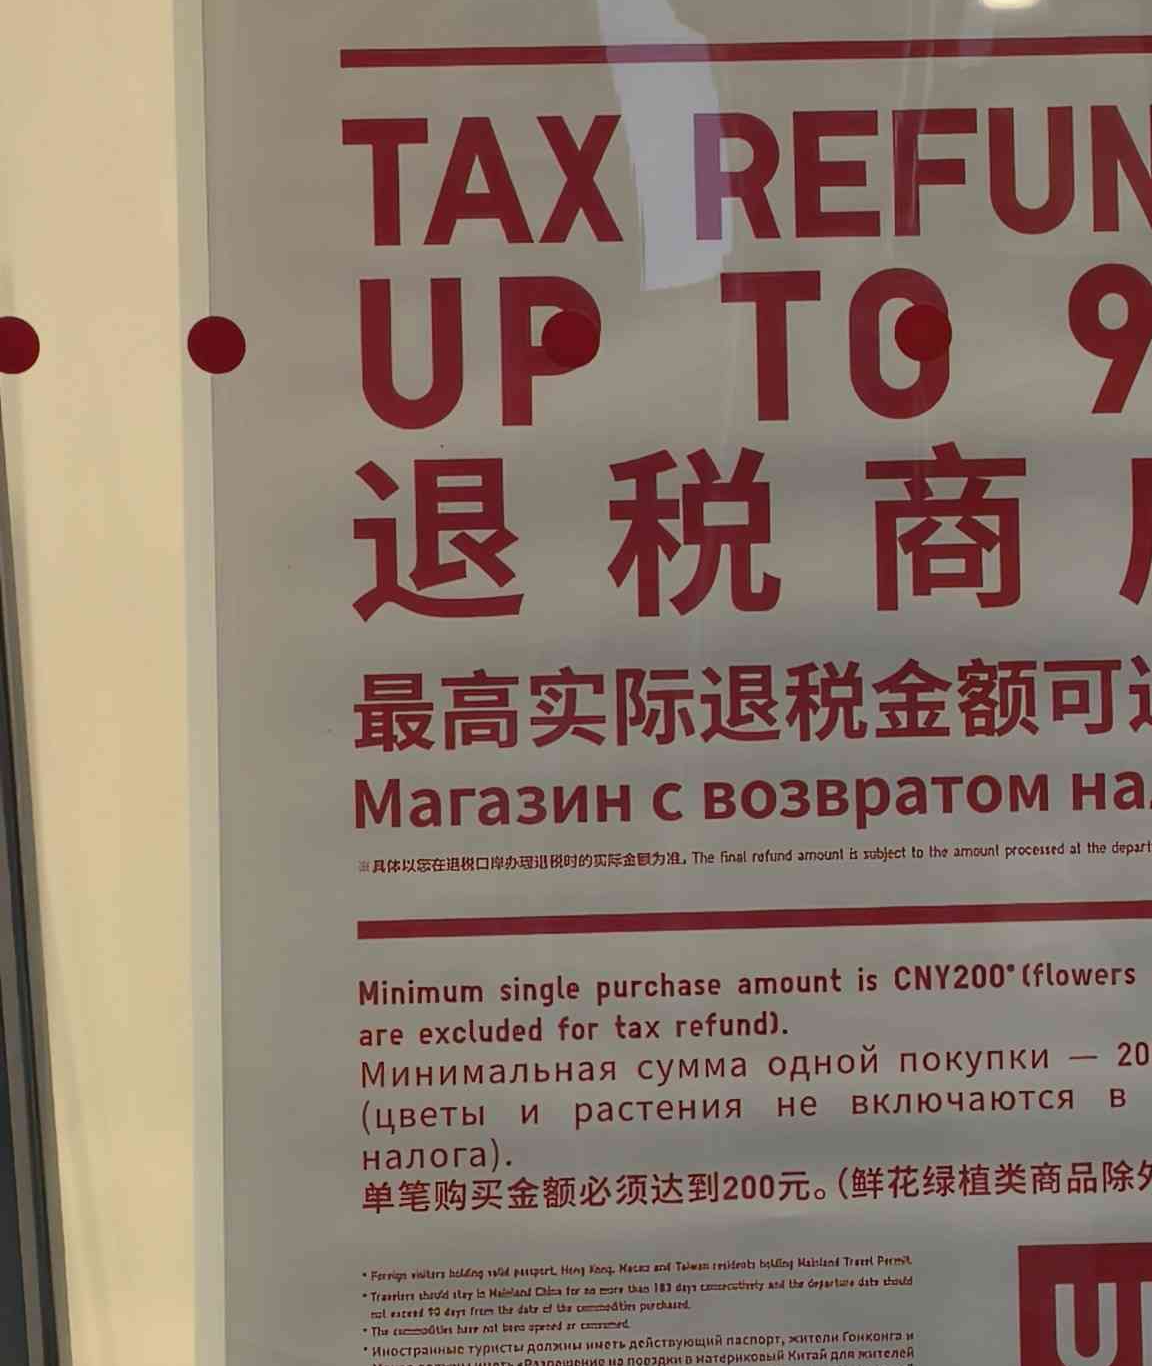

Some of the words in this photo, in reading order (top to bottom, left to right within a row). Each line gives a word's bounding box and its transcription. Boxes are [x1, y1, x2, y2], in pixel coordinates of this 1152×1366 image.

[341, 114, 623, 246] TAX
[359, 276, 598, 430] UP
[720, 267, 951, 421] TO
[355, 779, 630, 829] Магазин
[653, 782, 682, 821] с
[704, 774, 1048, 829] возвратом
[692, 852, 714, 863] The
[798, 849, 843, 861] amount
[850, 848, 858, 859] is
[864, 847, 905, 862] subject
[912, 846, 923, 858] to
[929, 845, 948, 857] the
[954, 844, 998, 857] amount
[1005, 843, 1064, 859] processed
[1070, 843, 1080, 854] at
[1088, 842, 1106, 853] the
[359, 980, 483, 1005] Minimum
[501, 975, 579, 1007] single
[597, 972, 720, 1006] purchase
[738, 968, 841, 995] amount
[858, 967, 877, 992] is
[360, 1028, 403, 1046] are
[420, 1017, 542, 1044] excluded
[558, 1016, 598, 1041] for
[615, 1015, 659, 1039] tax
[676, 1011, 787, 1037] refund).
[362, 1061, 615, 1088] Минимальная
[638, 1057, 746, 1085] сумма
[769, 1044, 877, 1081] одной
[901, 1049, 1048, 1076] покупки
[362, 1100, 484, 1135] (цветы
[522, 1104, 538, 1124] и
[576, 1099, 741, 1130] растения
[778, 1096, 816, 1117] не
[852, 1090, 1073, 1114] включаются
[1110, 1088, 1126, 1107] в
[363, 1138, 511, 1172] налога).
